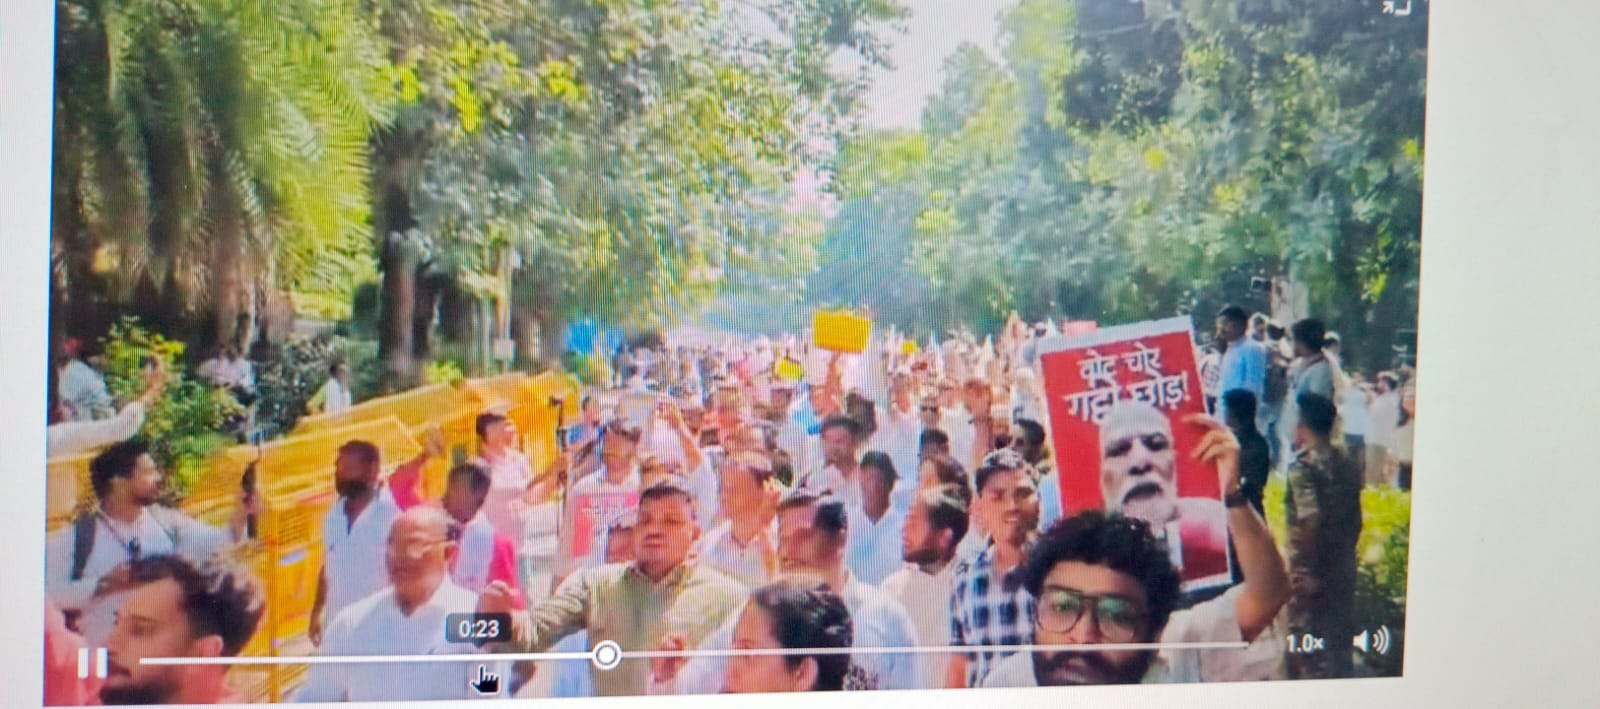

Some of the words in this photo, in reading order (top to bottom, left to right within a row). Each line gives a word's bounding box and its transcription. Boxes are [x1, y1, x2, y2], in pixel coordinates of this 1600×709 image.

[1077, 348, 1119, 387] वोट
[1121, 341, 1162, 376] चोर
[459, 619, 500, 638] 0:23
[1286, 633, 1325, 653] 1.0x
